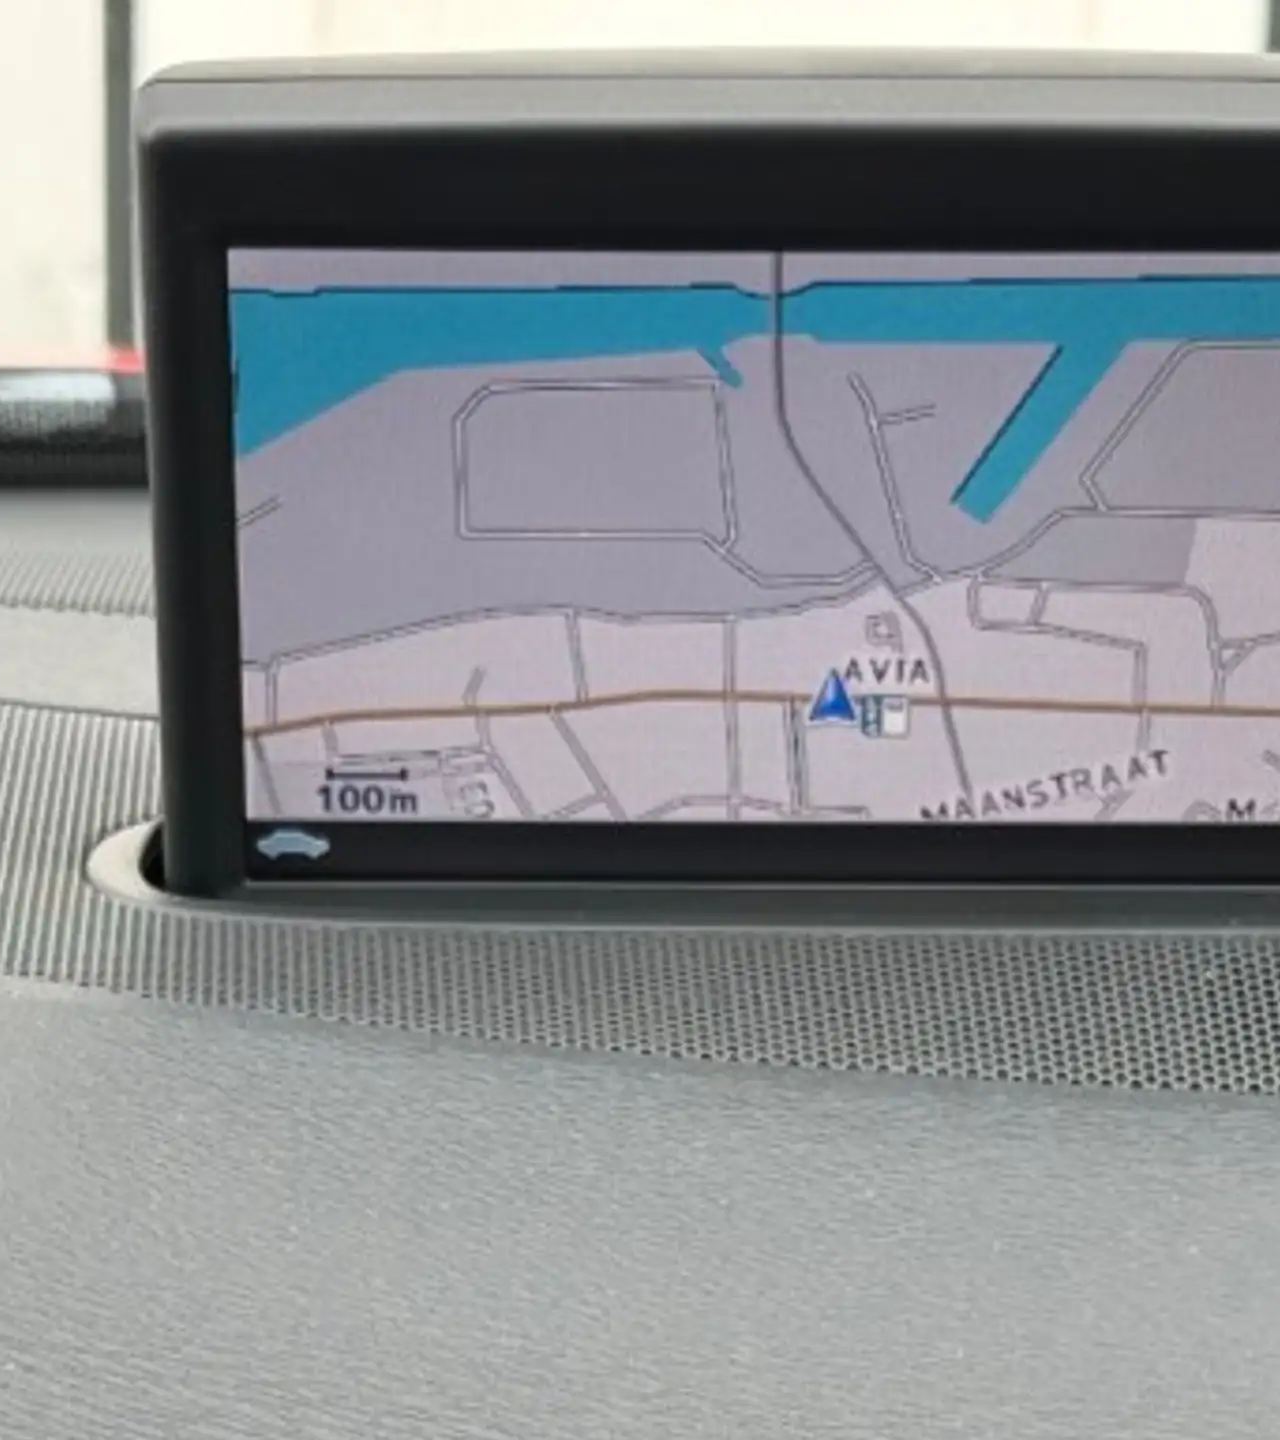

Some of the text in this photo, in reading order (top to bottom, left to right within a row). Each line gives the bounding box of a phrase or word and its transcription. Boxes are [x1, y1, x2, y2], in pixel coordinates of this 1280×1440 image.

[844, 656, 930, 684] AVIA
[317, 784, 419, 814] 100m
[920, 749, 1169, 820] MAANSTRAAT
